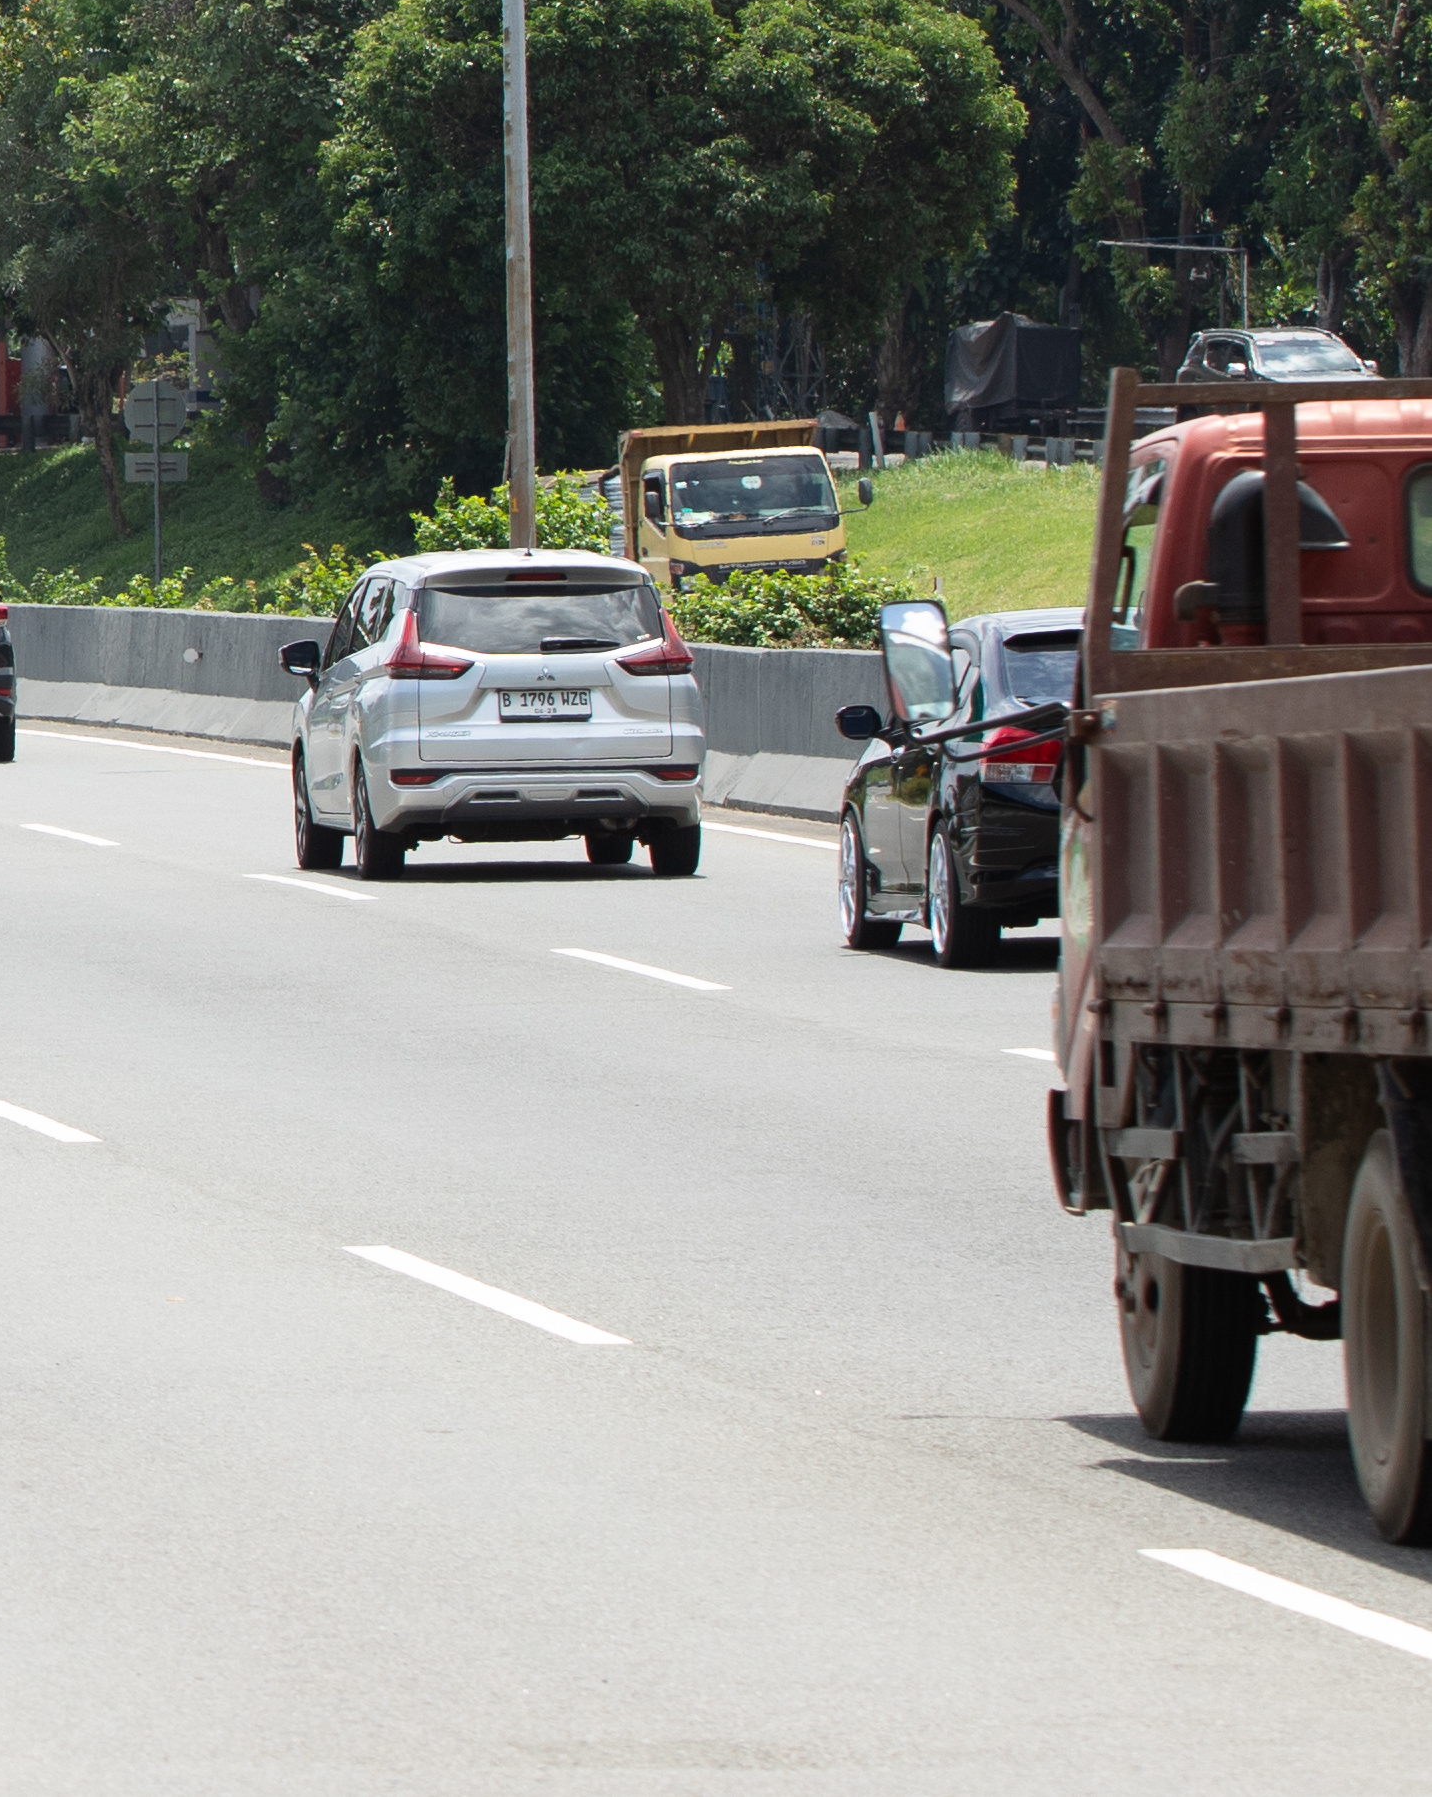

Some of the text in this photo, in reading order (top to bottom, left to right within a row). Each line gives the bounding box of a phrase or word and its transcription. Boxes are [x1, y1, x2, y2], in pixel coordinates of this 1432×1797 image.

[502, 690, 588, 708] B 1796 WZG
